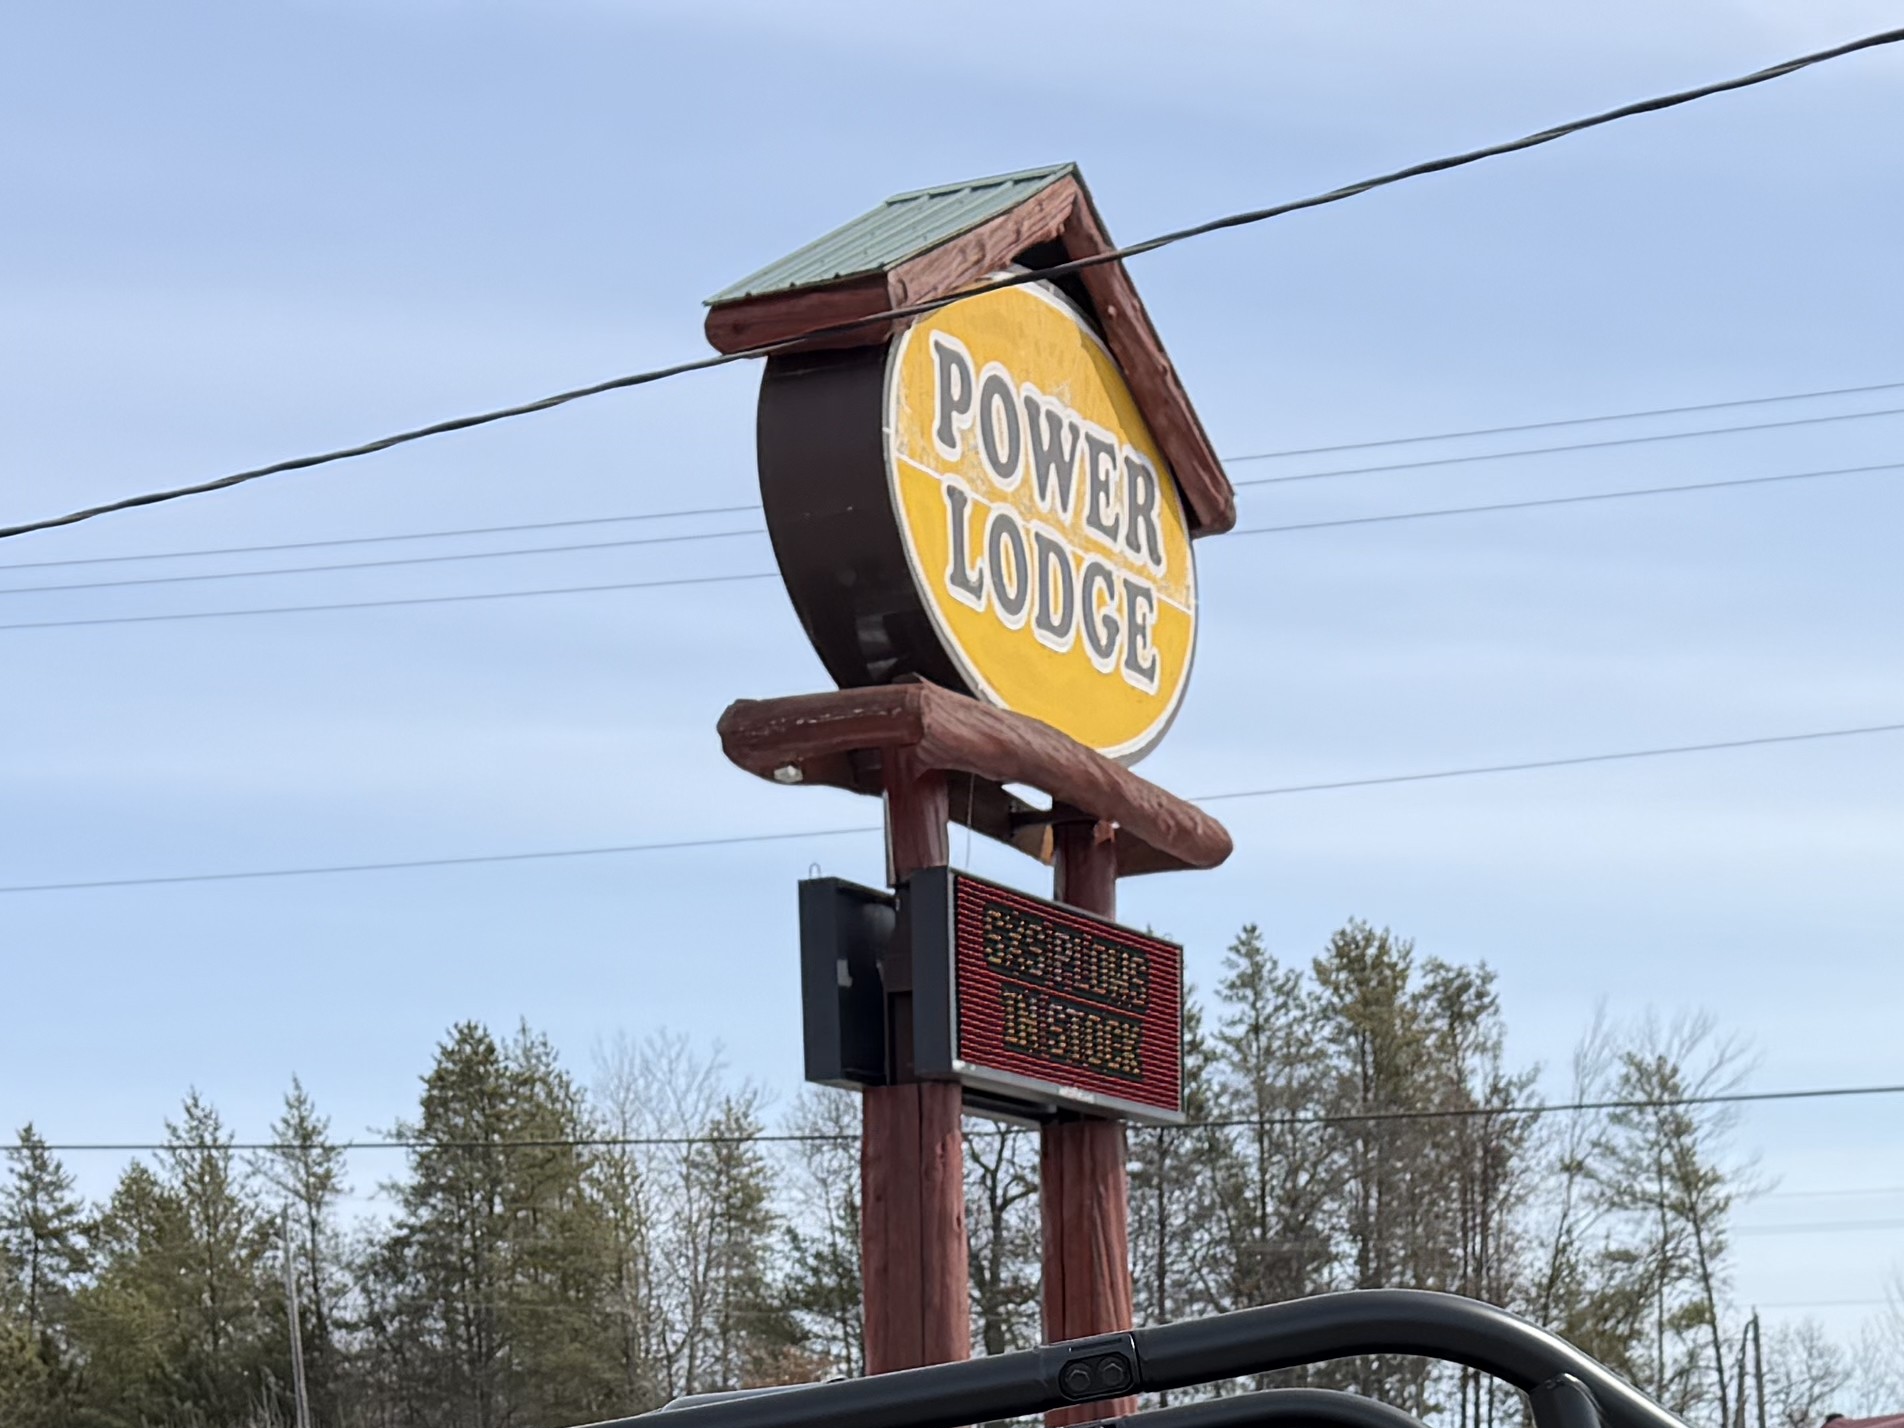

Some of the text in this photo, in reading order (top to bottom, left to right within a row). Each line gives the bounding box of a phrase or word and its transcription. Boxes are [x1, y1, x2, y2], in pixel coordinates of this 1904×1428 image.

[932, 335, 1166, 571] POWER
[945, 483, 1159, 688] LODGE
[1003, 990, 1143, 1075] IN STOCK
